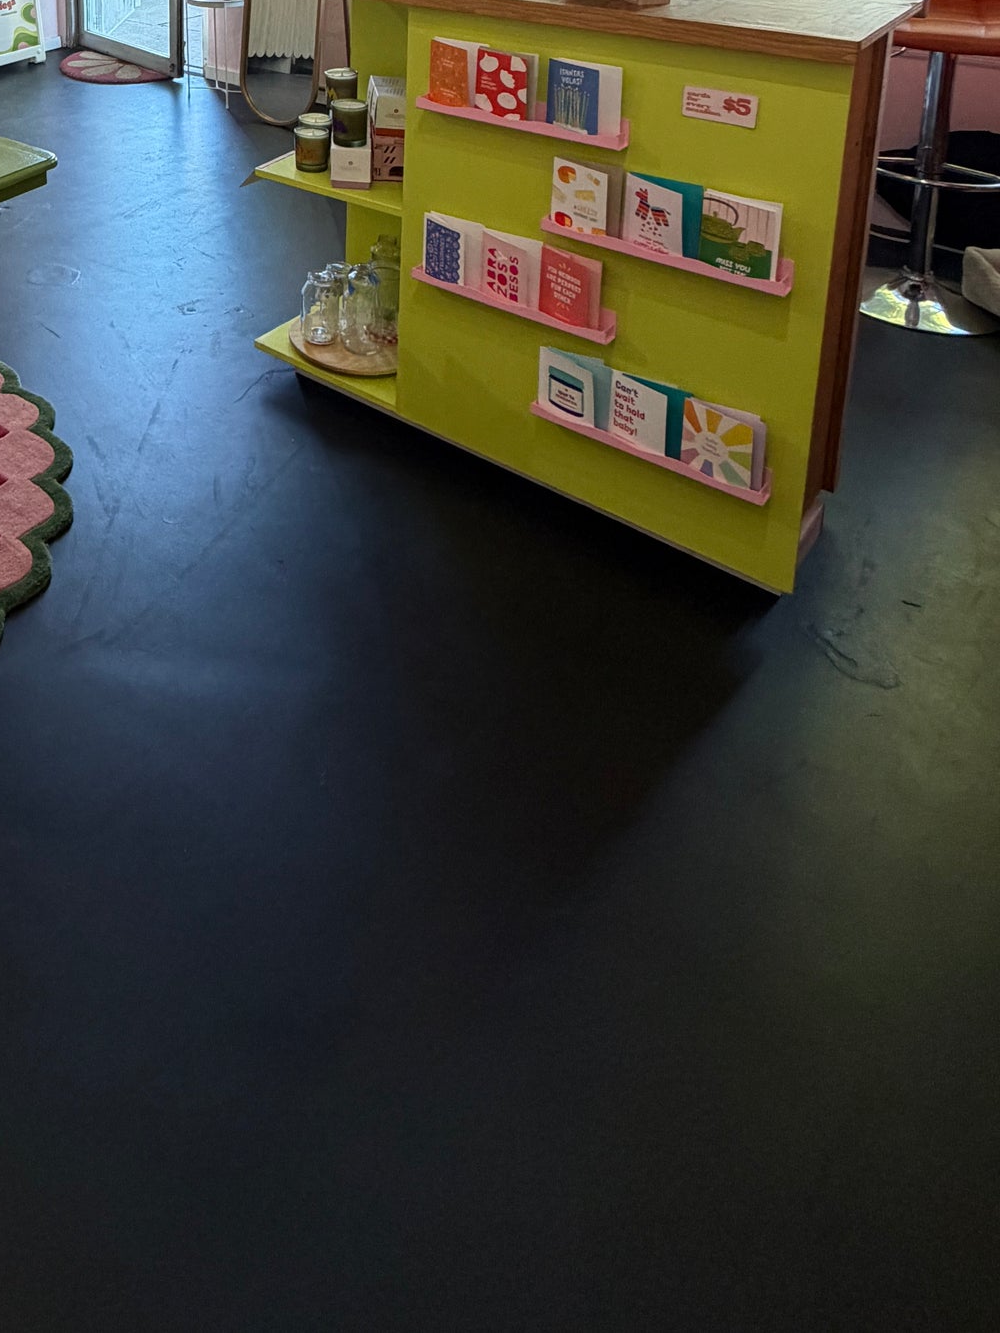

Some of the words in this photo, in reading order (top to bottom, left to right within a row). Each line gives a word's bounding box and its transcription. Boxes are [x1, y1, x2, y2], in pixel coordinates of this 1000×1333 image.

[723, 97, 751, 116] $5
[487, 248, 498, 293] ABRA
[735, 263, 751, 273] YOU
[497, 264, 508, 298] ZOS
[509, 257, 519, 303] BESOS
[616, 380, 639, 398] Can't
[615, 392, 636, 406] wait
[614, 401, 624, 411] to
[626, 406, 646, 420] hold
[614, 410, 634, 425] that
[613, 418, 638, 437] baby!
